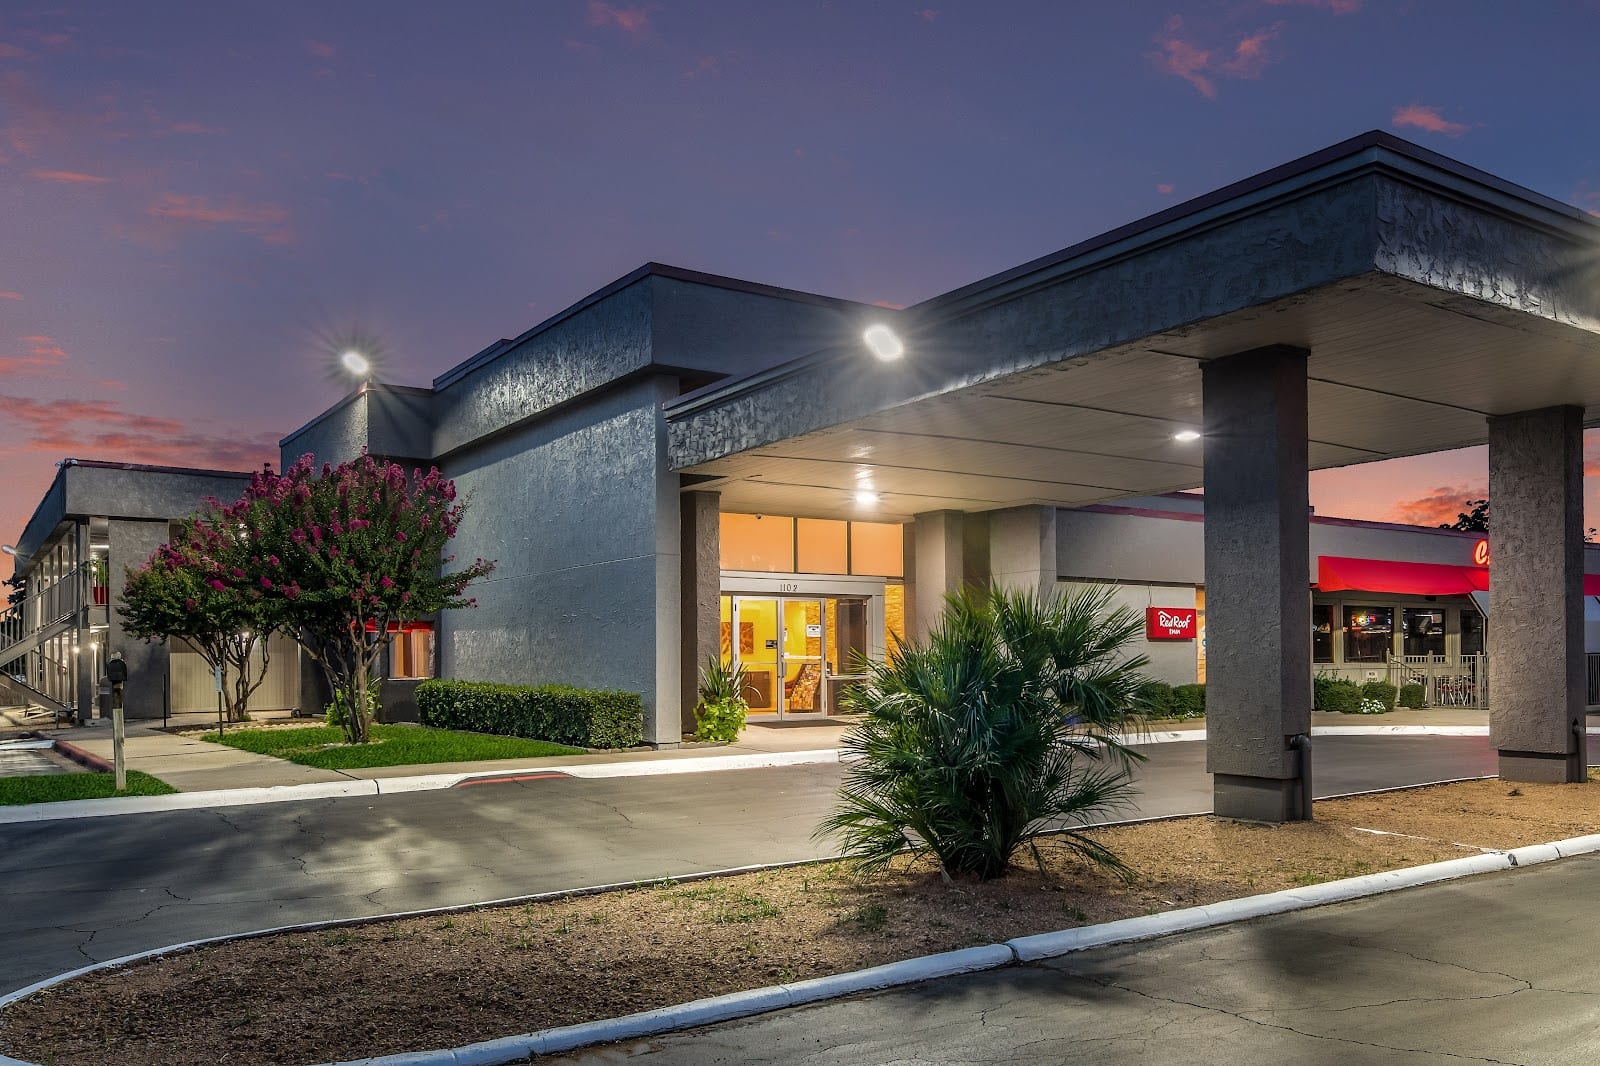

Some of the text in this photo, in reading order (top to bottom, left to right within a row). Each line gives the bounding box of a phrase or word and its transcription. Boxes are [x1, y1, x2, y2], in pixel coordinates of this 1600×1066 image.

[780, 583, 798, 592] 1102
[1159, 615, 1191, 629] Red Roof
